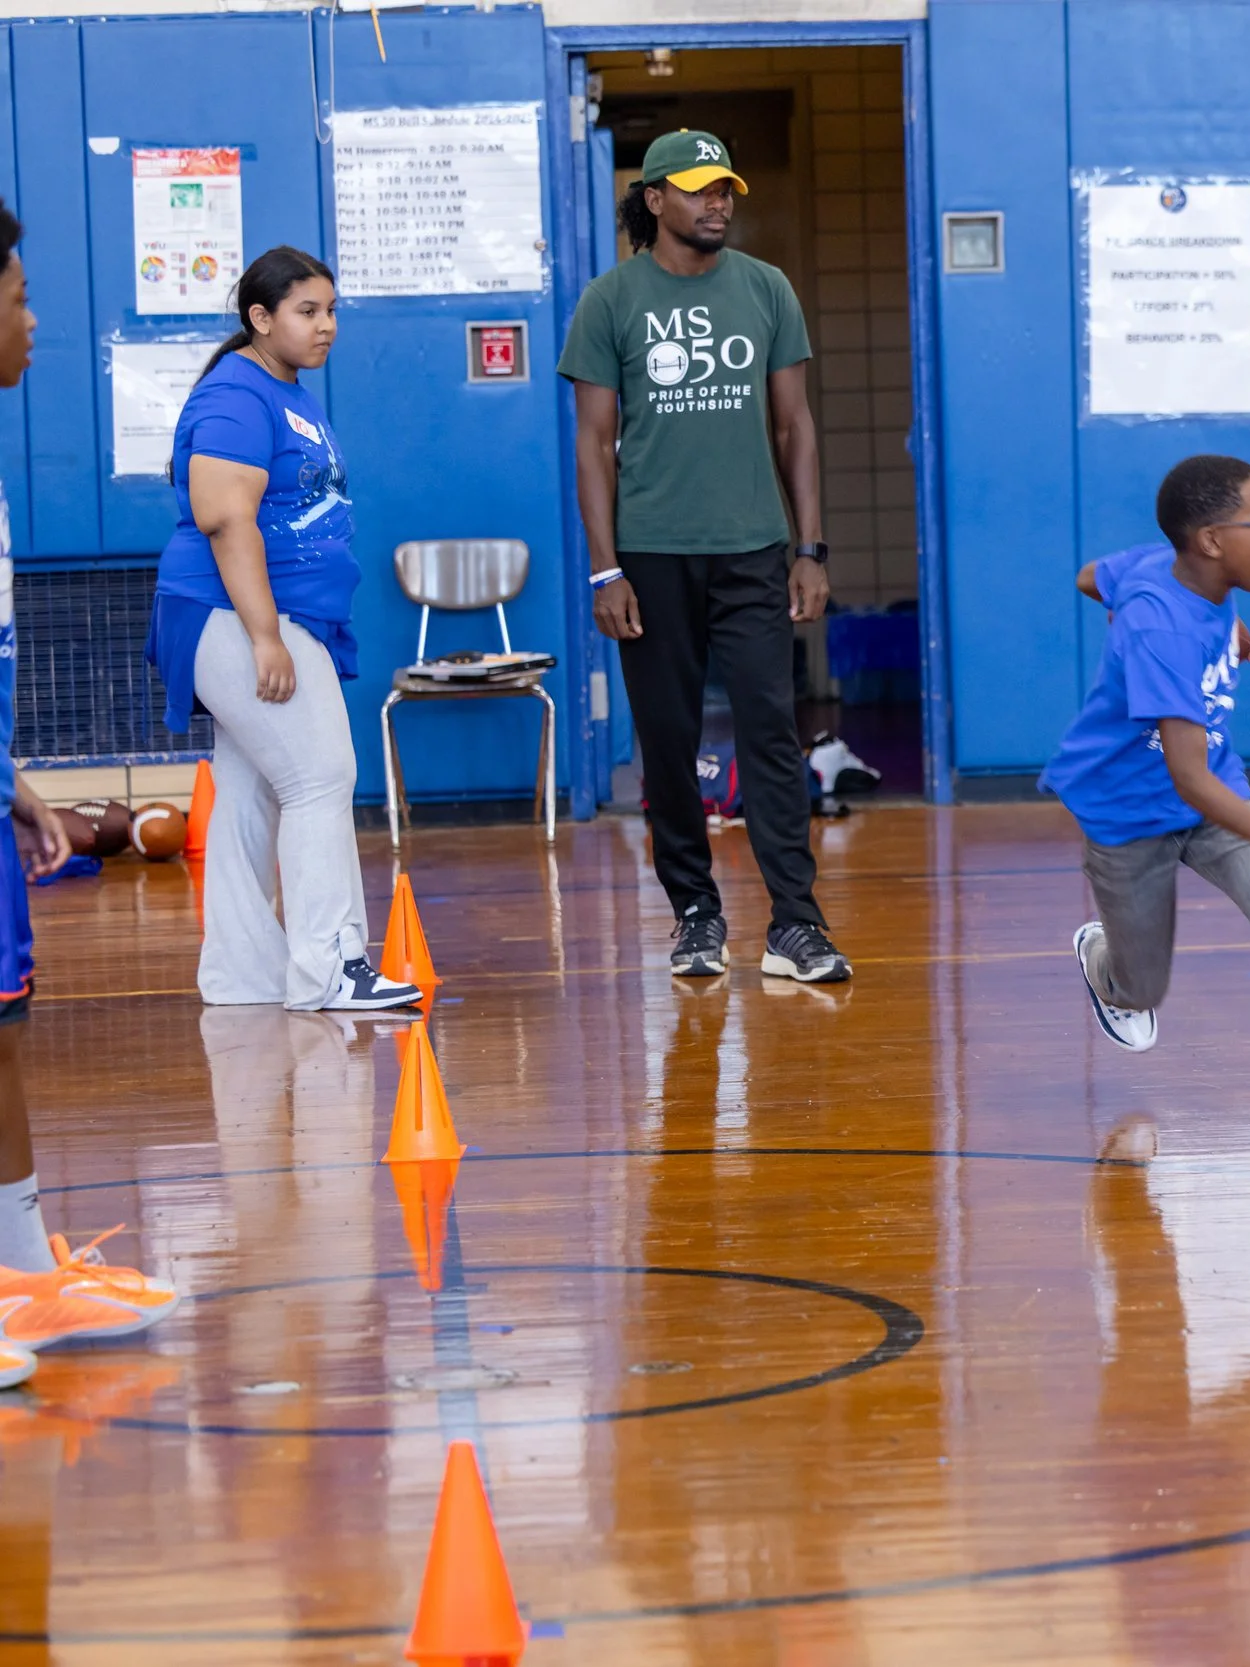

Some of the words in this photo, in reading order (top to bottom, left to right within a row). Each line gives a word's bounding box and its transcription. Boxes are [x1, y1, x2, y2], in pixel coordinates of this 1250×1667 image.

[644, 306, 713, 345] MS
[689, 335, 755, 384] 50
[648, 388, 694, 403] PRIDE
[699, 386, 718, 397] OF
[723, 385, 751, 397] THE
[656, 399, 743, 414] SOUTHSIDE
